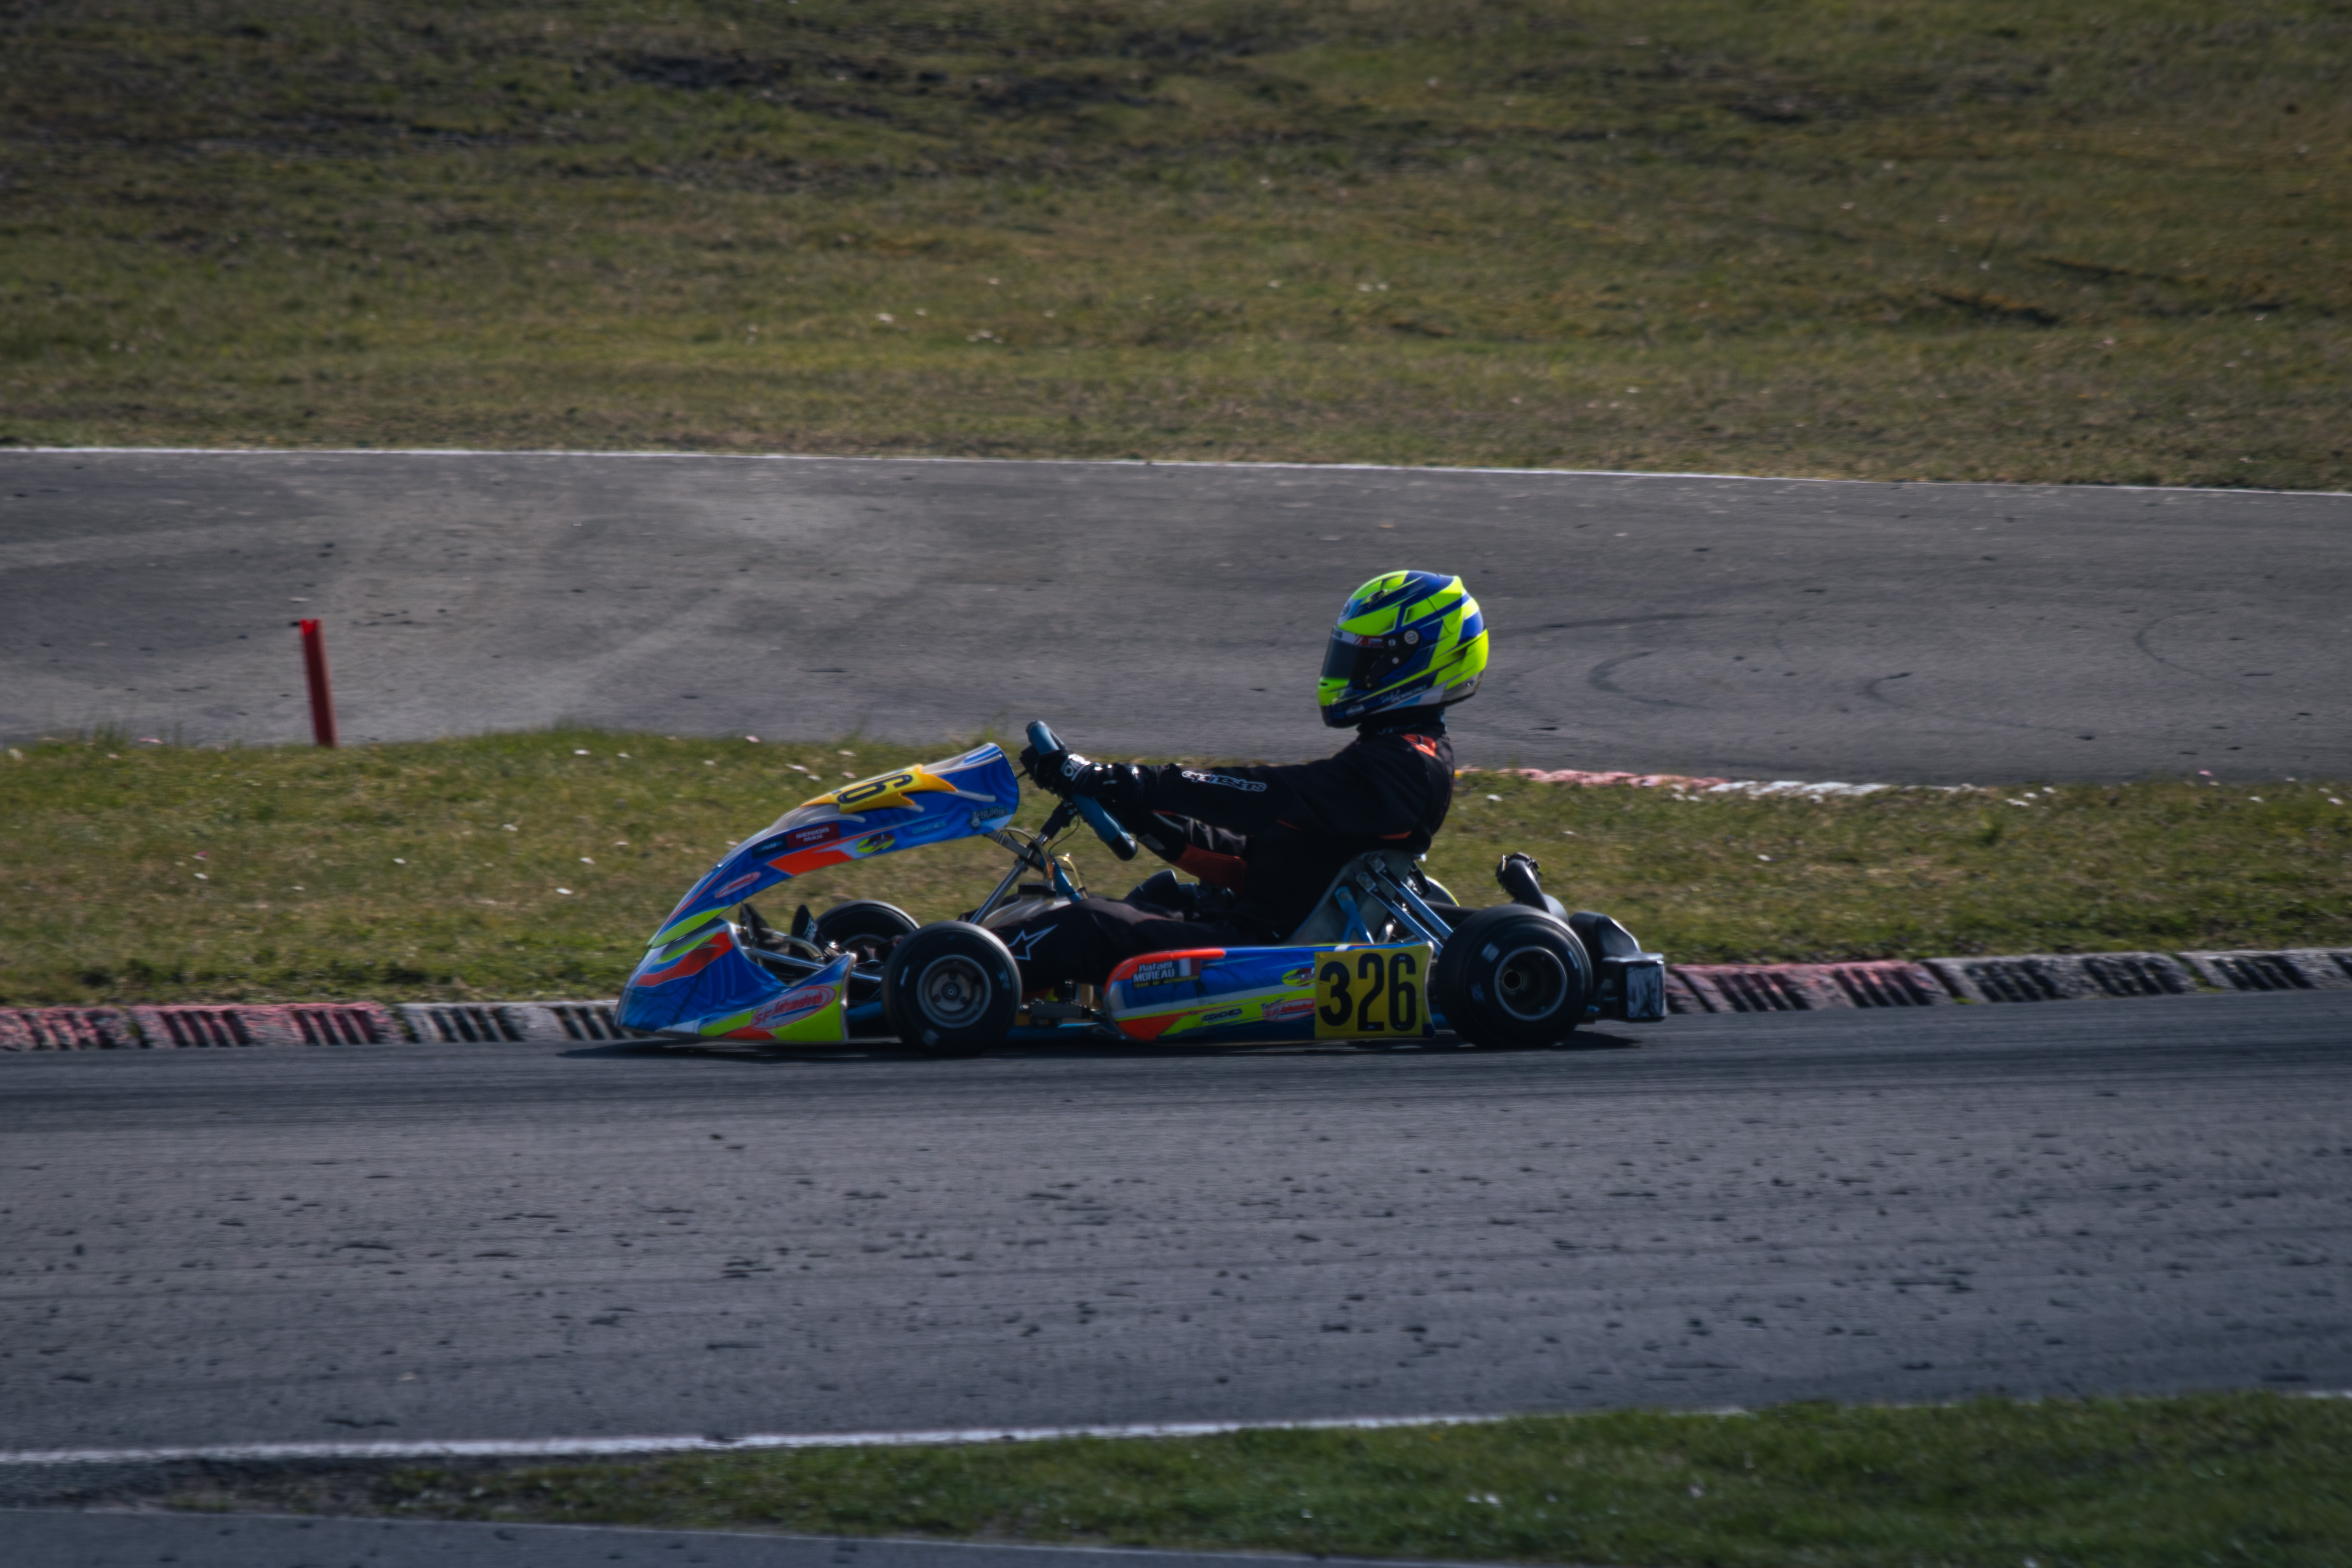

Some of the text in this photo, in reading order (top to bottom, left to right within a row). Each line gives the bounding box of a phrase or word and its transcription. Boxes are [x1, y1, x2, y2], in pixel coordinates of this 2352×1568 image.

[795, 826, 830, 839] SENIOR
[803, 834, 823, 842] MAX
[1133, 968, 1175, 983] MOREAU
[1319, 953, 1416, 1032] 326
[754, 1010, 772, 1025] SF
